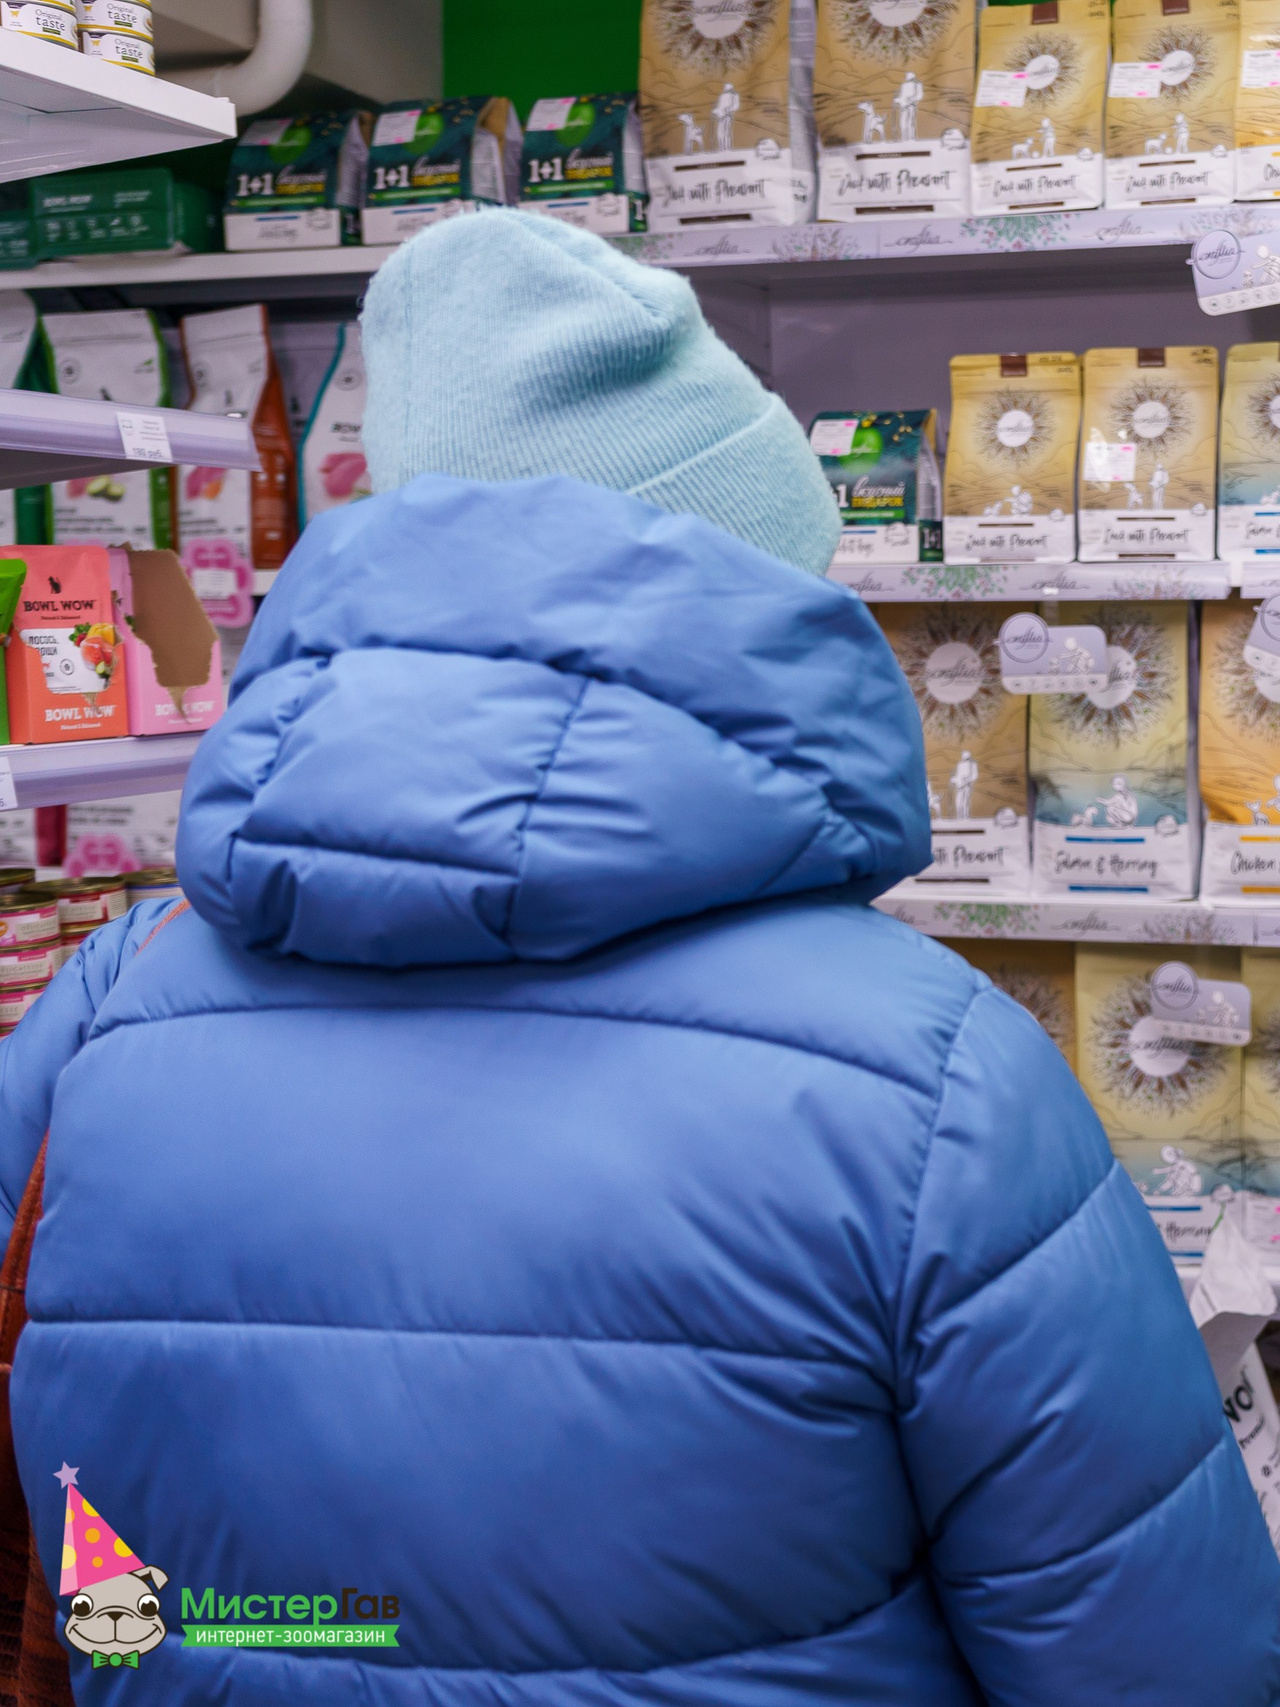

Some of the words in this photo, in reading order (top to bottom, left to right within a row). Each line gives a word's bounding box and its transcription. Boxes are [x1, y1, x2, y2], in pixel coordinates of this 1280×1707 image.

[36, 17, 66, 31] taste
[108, 10, 137, 23] taste
[115, 45, 143, 58] taste
[374, 164, 409, 190] 1+1
[529, 157, 563, 182] 1+1
[237, 173, 273, 197] 1+1
[24, 601, 58, 613] BOWL
[60, 599, 96, 611] WOW
[45, 706, 82, 723] BOWL
[84, 704, 117, 718] WOW
[1231, 851, 1275, 874] Chicken
